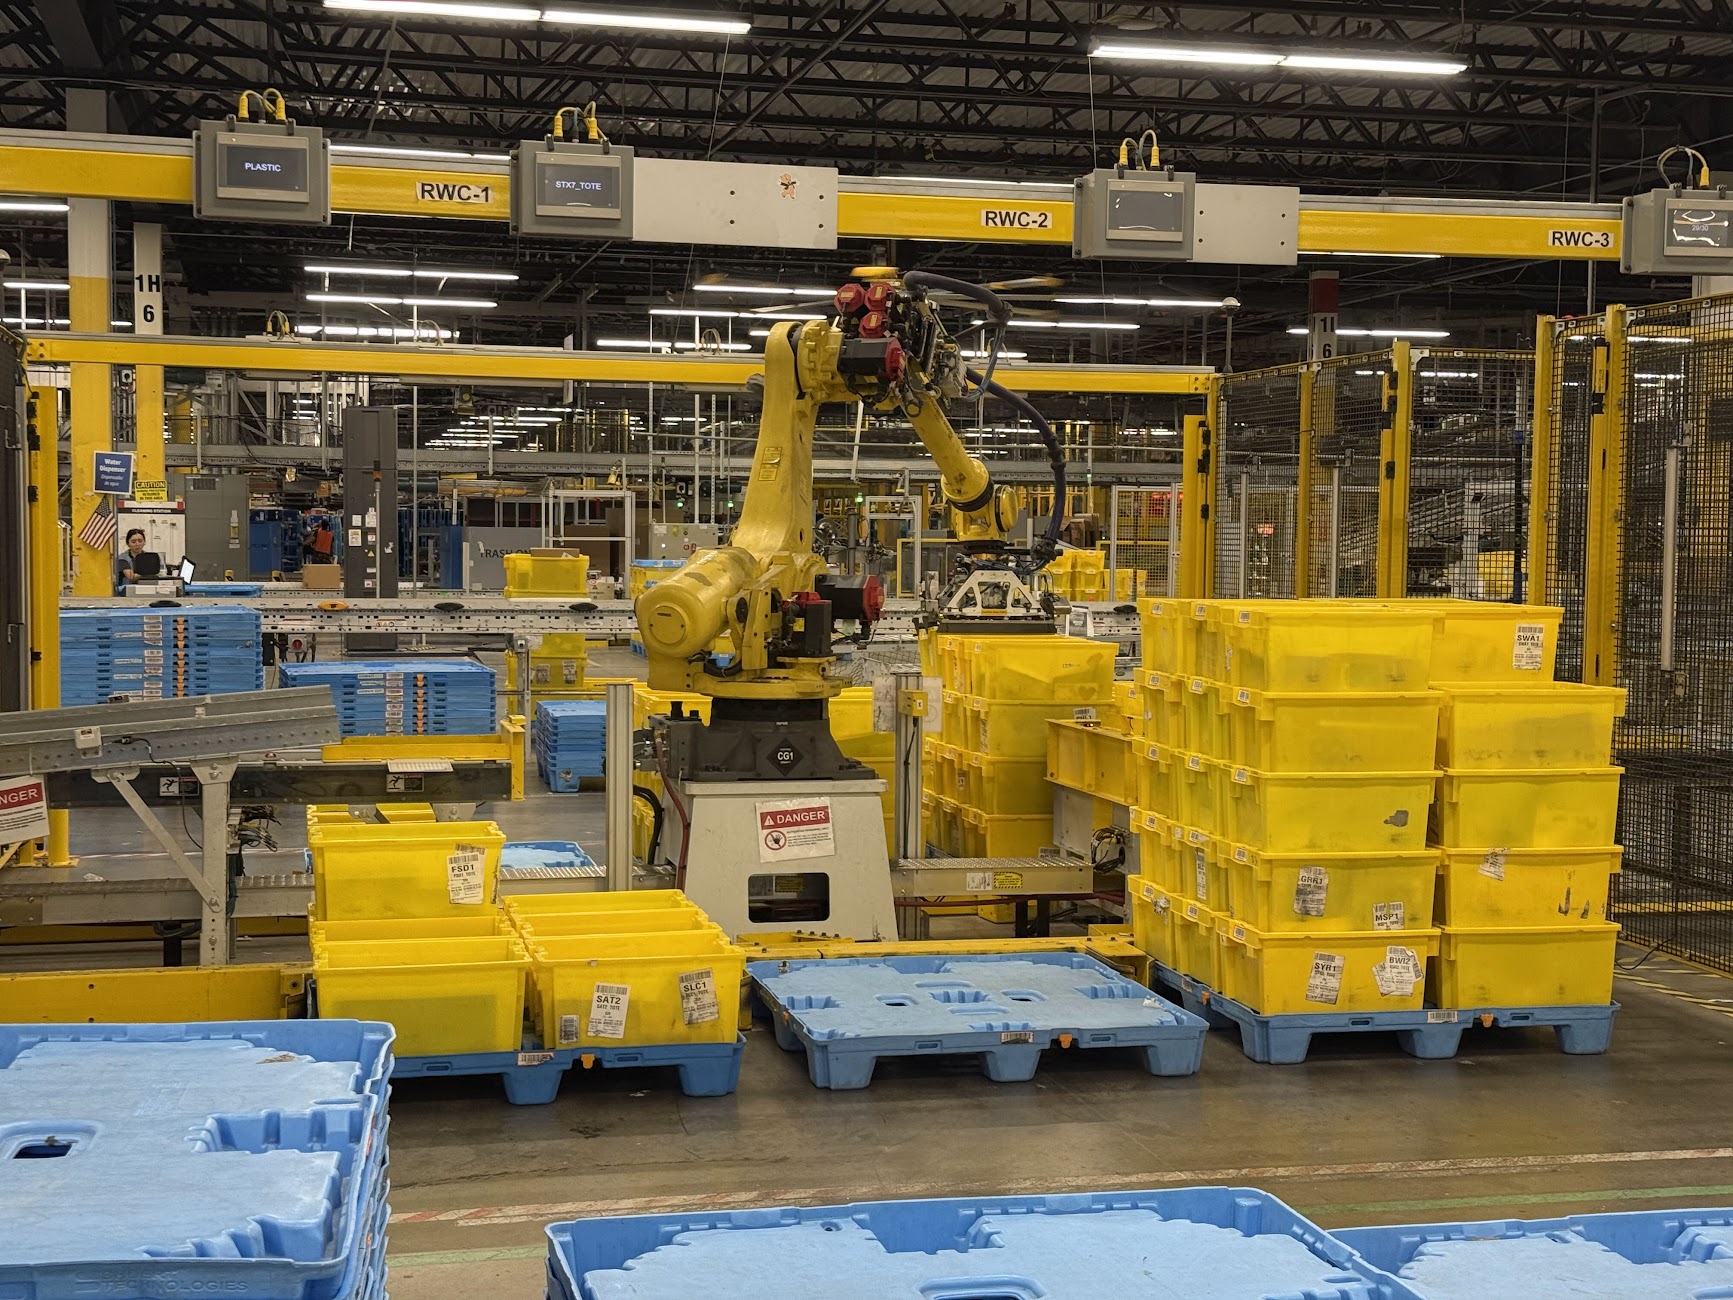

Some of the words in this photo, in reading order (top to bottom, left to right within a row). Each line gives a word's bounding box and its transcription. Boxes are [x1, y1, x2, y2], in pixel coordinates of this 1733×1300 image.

[244, 162, 282, 172] PLASTIC
[555, 180, 602, 191] STX7_TOTE
[420, 182, 490, 203] RWC-1
[985, 210, 1048, 228] RWC-2
[1551, 230, 1610, 248] RWC-3
[135, 274, 161, 293] 1H
[143, 304, 155, 323] 6
[1322, 343, 1332, 358] 6
[104, 458, 122, 466] Water
[99, 465, 127, 473] Dispenser
[1517, 634, 1540, 642] SWA1
[777, 751, 794, 760] CG1
[776, 810, 826, 824] DANGER
[451, 864, 475, 873] FSD1
[1375, 913, 1399, 921] MSP1
[1389, 956, 1411, 965] BWI2
[1314, 962, 1336, 972] SYR1
[683, 981, 707, 993] SLC1
[596, 995, 621, 1005] SAT2
